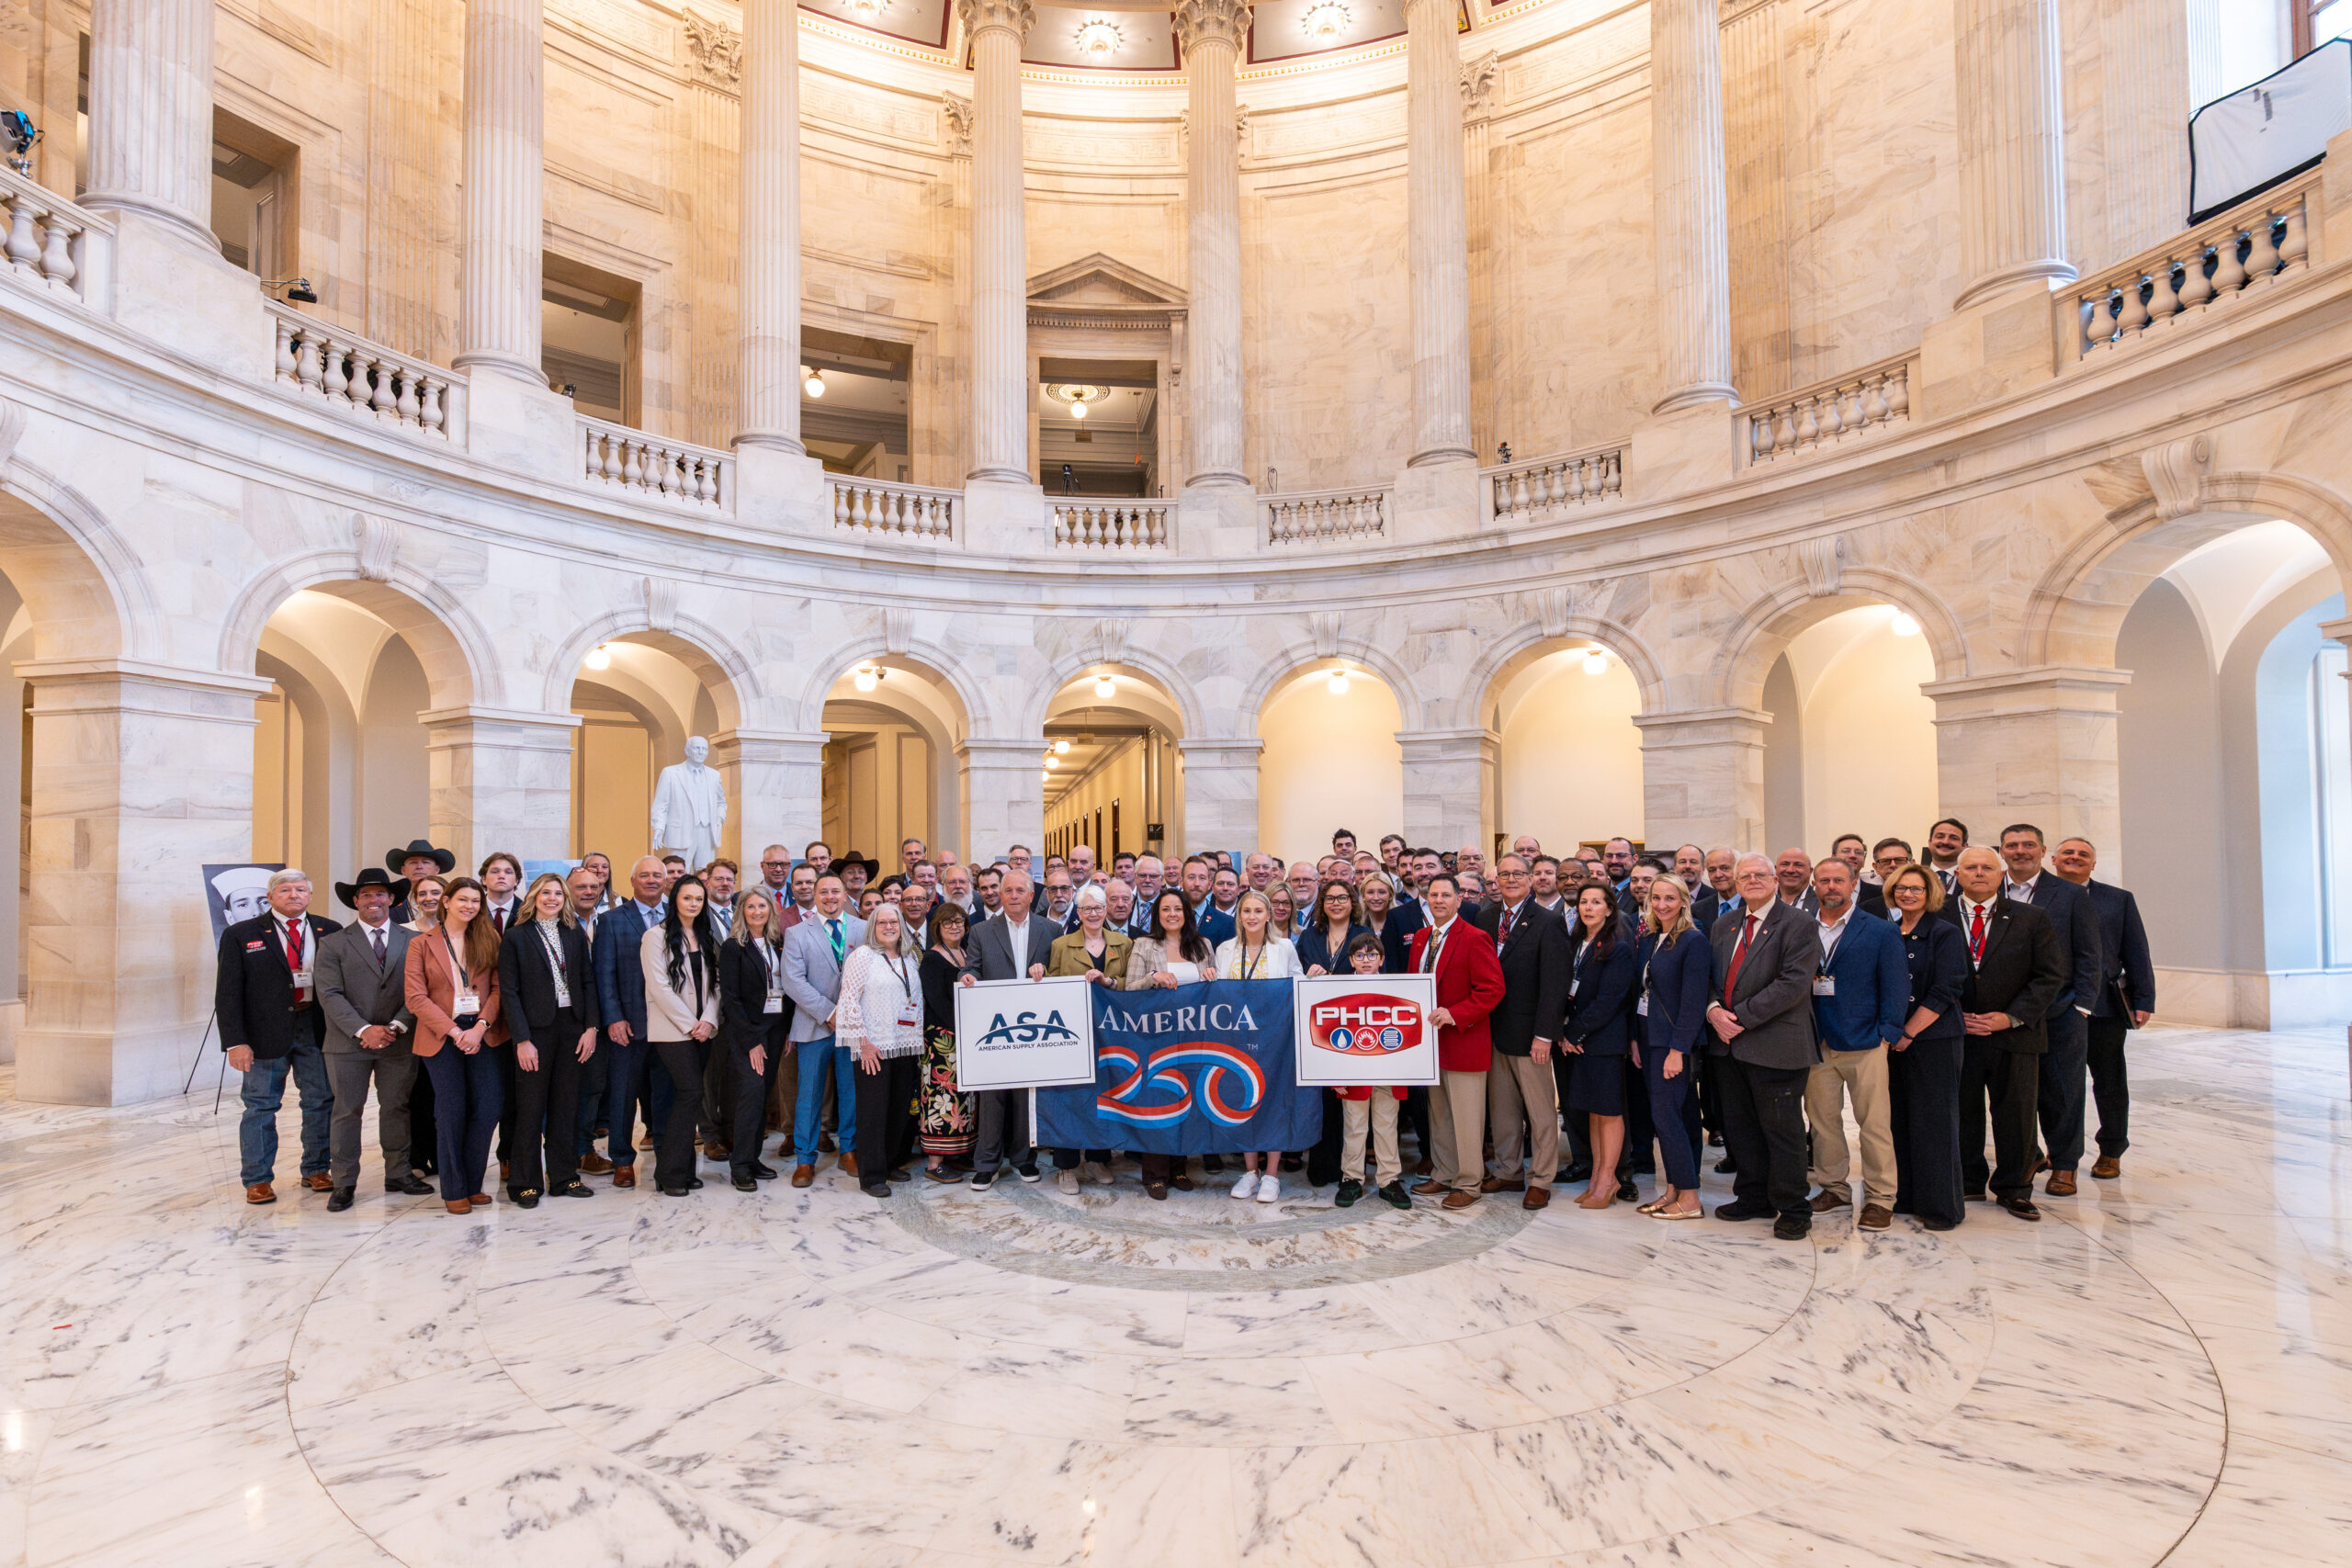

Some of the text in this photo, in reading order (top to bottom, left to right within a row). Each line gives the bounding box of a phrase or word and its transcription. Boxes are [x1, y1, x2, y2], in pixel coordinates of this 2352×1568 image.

[985, 1010, 1071, 1044] ASA
[1098, 1003, 1260, 1033] AMERICA
[1316, 1006, 1417, 1026] PHCC
[1036, 1040, 1079, 1049] ASSOCIATION
[1097, 1041, 1266, 1129] 250
